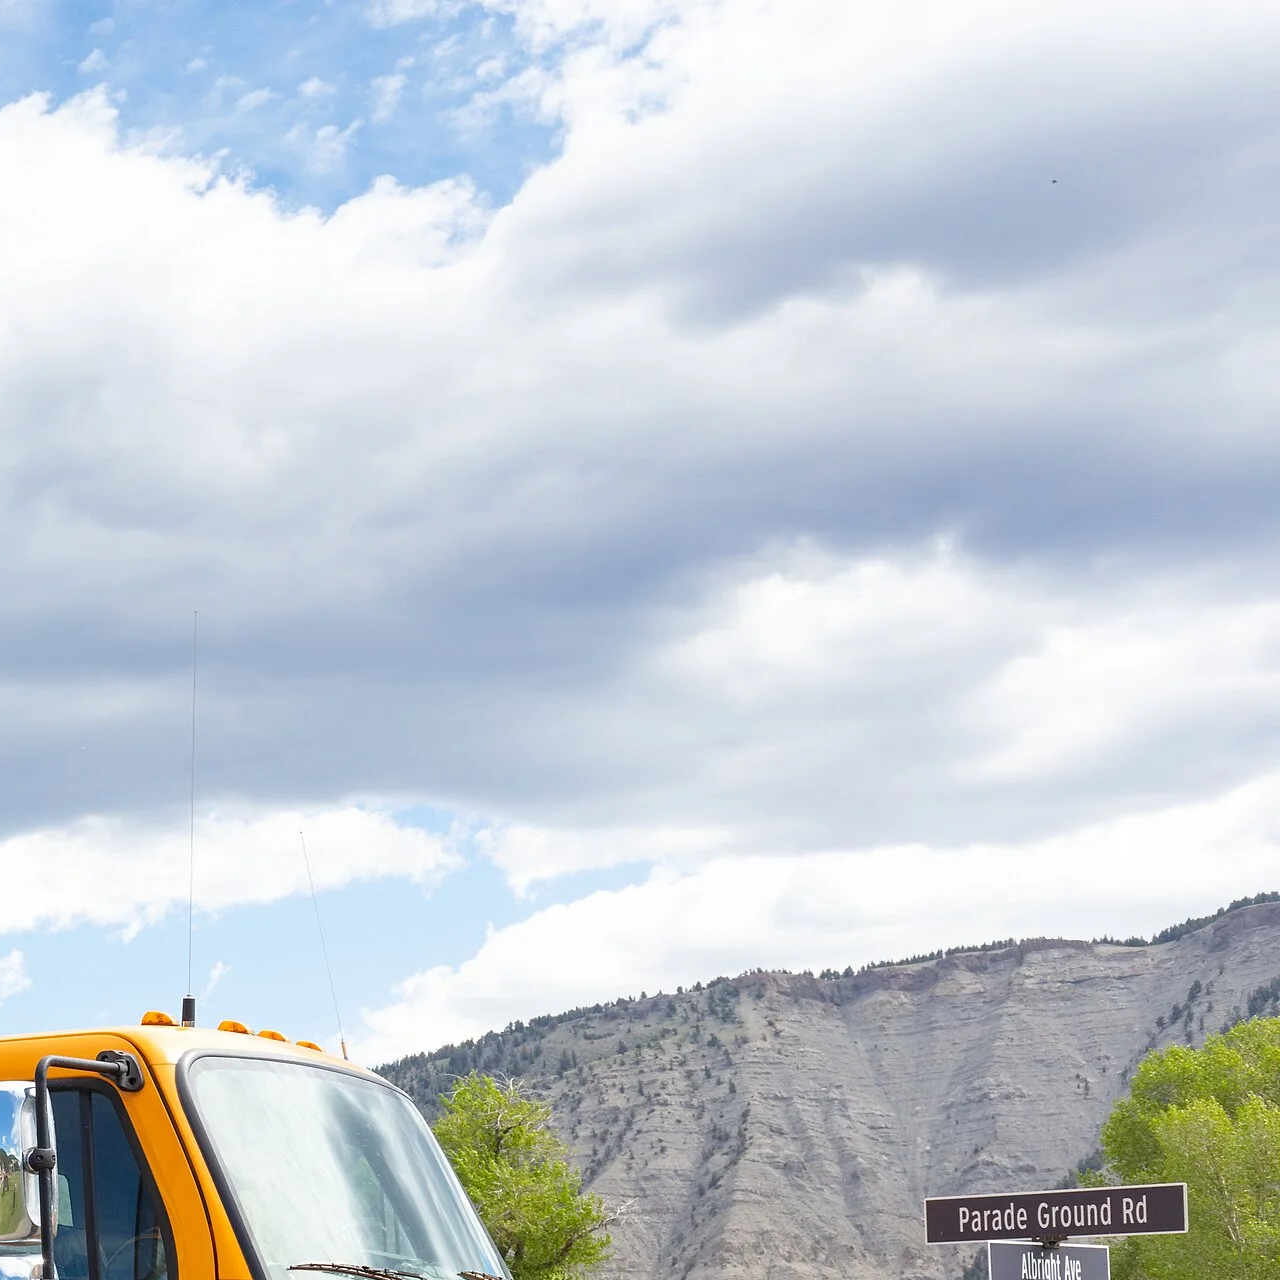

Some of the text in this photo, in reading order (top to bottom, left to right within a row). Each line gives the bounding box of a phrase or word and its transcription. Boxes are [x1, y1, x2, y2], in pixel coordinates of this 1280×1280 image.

[958, 1195, 1148, 1232] Parade Ground Rd
[1064, 1255, 1081, 1280] Ave
